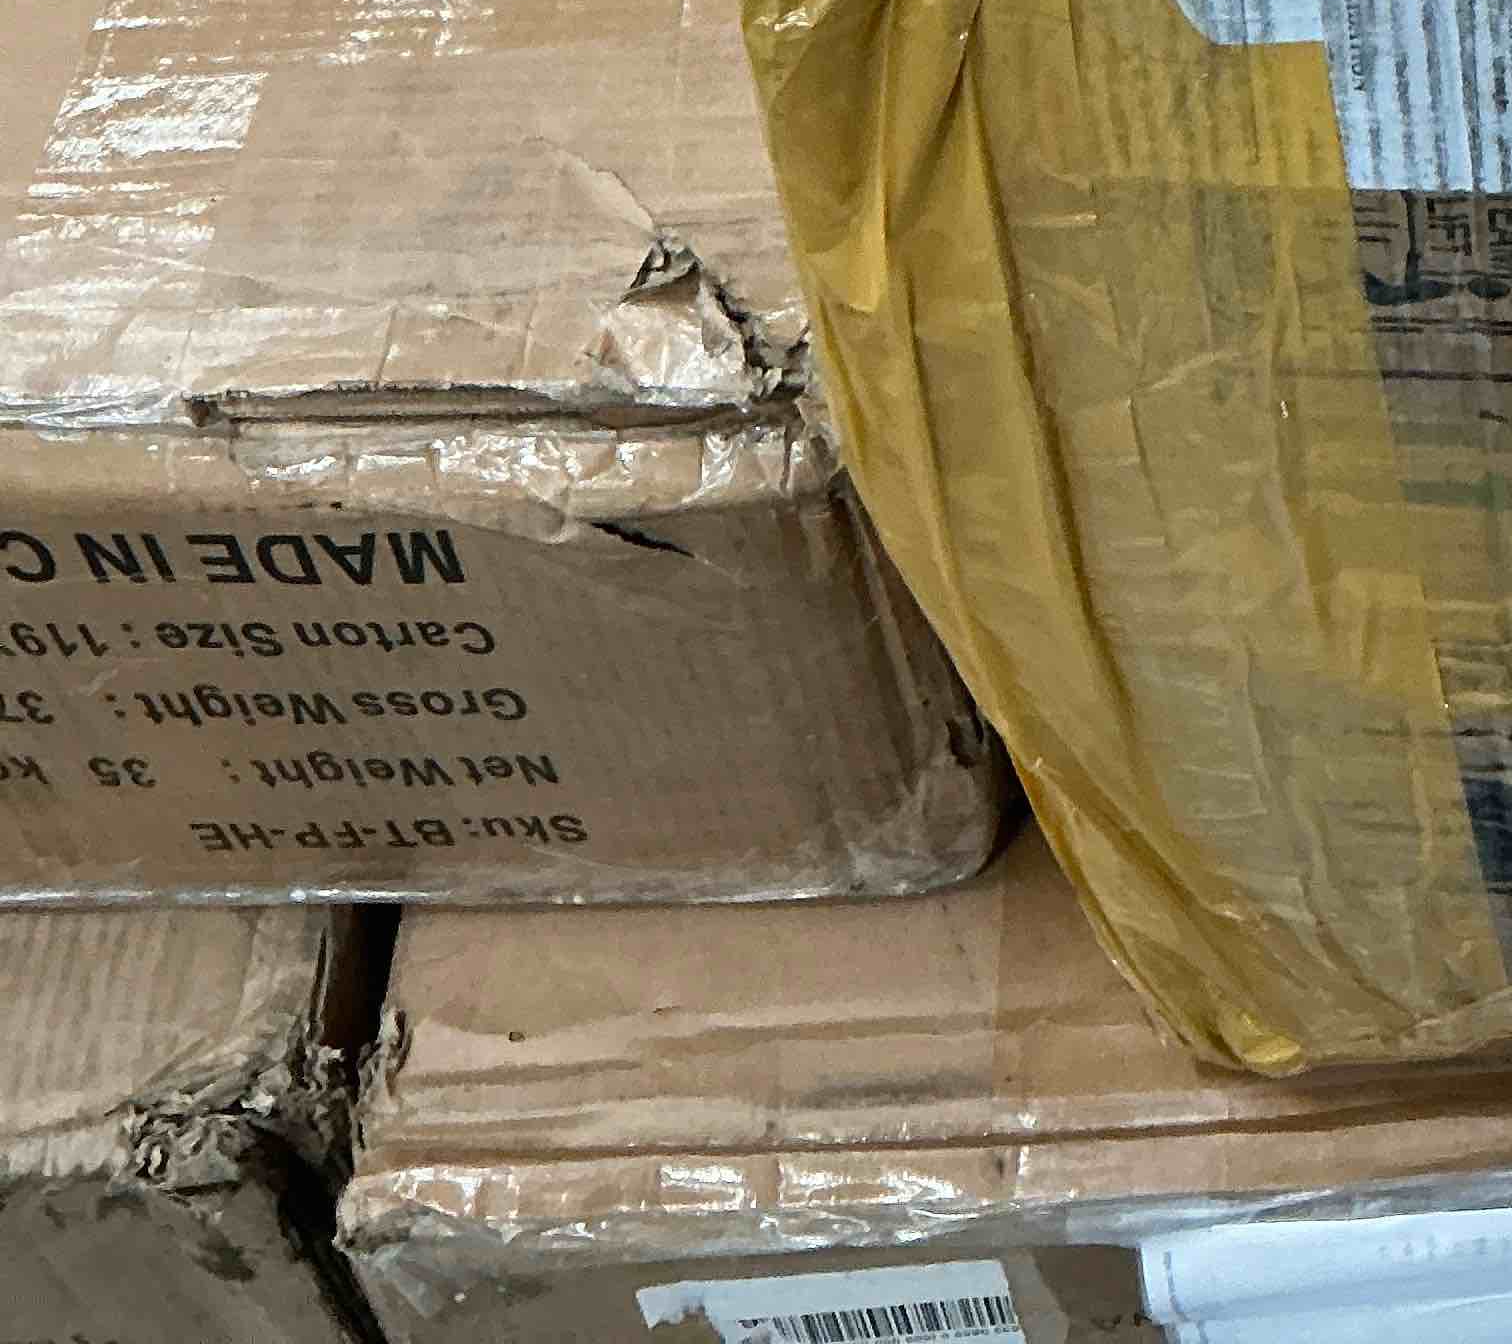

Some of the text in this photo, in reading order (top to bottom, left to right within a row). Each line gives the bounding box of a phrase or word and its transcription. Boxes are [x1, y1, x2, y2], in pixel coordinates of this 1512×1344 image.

[73, 531, 176, 585] IN
[186, 529, 466, 587] MADE
[292, 619, 497, 657] Carton
[353, 685, 529, 722] Gross
[87, 754, 158, 788] 35
[455, 753, 560, 786] Net
